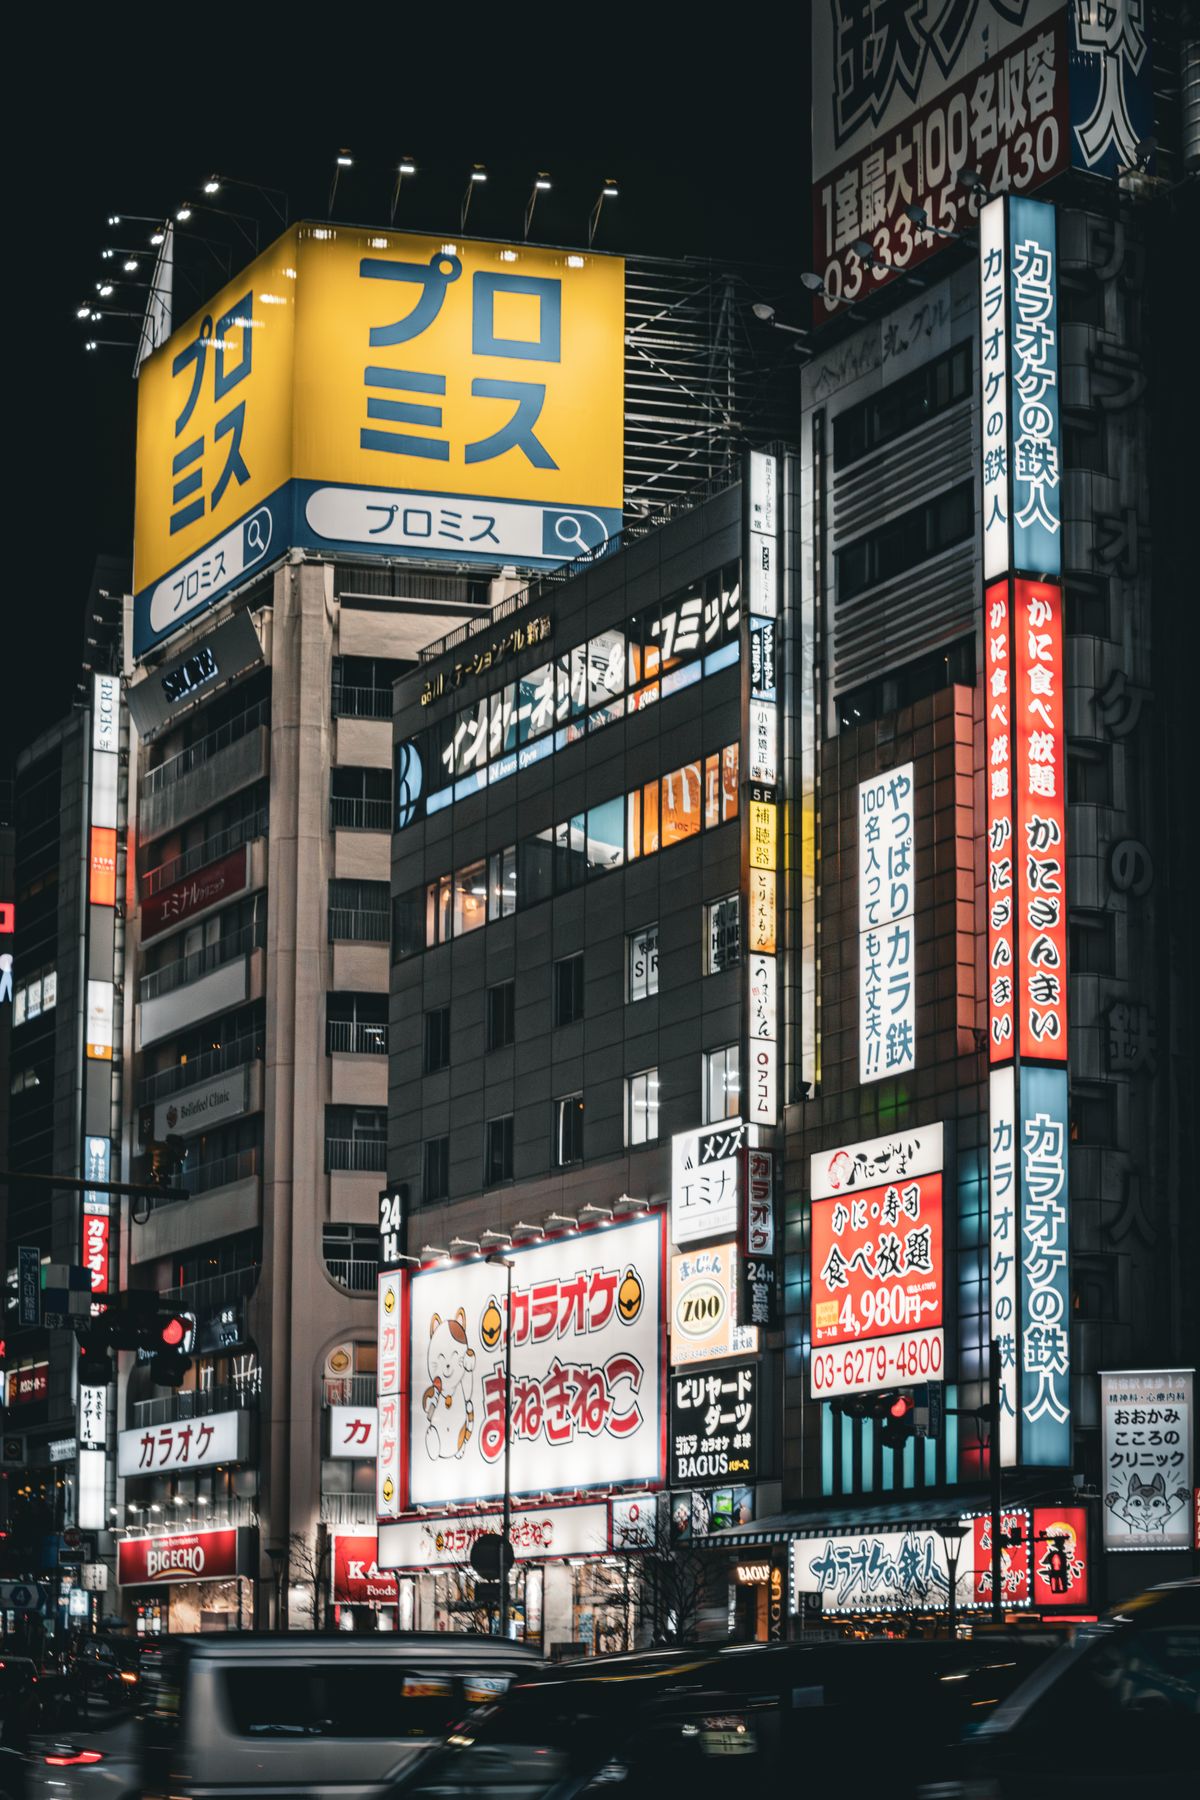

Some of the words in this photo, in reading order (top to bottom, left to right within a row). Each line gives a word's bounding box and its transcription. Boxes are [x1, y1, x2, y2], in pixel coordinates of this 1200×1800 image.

[822, 29, 1056, 258] 1室最大100名収容
[359, 252, 562, 363] プロ
[173, 290, 253, 438] プロ
[984, 247, 1007, 533] カラオケの鉄人
[1012, 239, 1061, 534] カラオケの鉄人
[359, 365, 561, 471] ミス
[169, 400, 251, 536] ミス
[366, 504, 501, 544] プロミス
[173, 551, 227, 613] プロミス
[100, 678, 112, 734] SECRE
[989, 600, 1011, 800] かに食べ放題
[1027, 597, 1057, 797] かに食べ放題
[753, 789, 772, 801] 5F
[755, 806, 770, 865] 補聴器
[757, 875, 768, 945] とりえもん
[861, 785, 886, 1075] 100名入っても大丈夫!!
[886, 774, 913, 1069] やっぱりカラ鉄
[989, 817, 1011, 1045] かにざんまい
[1024, 814, 1061, 1043] かにざんまい
[757, 1070, 769, 1112] アコム
[702, 1126, 745, 1163] メンズ
[847, 1139, 921, 1186] かにざんまい
[379, 1194, 401, 1235] 24
[679, 1170, 738, 1208] エミナ
[751, 1155, 770, 1252] カラオケ
[833, 1184, 920, 1235] かに・寿司
[86, 1217, 105, 1288] カラオケ
[383, 1233, 398, 1262] H
[821, 1226, 932, 1291] 食べ放題
[1022, 1113, 1070, 1425] カラオケの鉄人
[502, 1271, 618, 1346] カラオケ
[683, 1295, 720, 1323] ZOO
[677, 1370, 752, 1408] ビリヤード
[813, 1336, 942, 1391] 03-6279-4800
[84, 1390, 93, 1439] ルノアール
[383, 1327, 396, 1465] カラオケ
[481, 1356, 642, 1461] まねきねこ
[704, 1402, 753, 1436] ダーツ
[1114, 1408, 1181, 1425] おおかみ
[139, 1422, 215, 1468] カラオケ
[675, 1441, 698, 1456] ゴルフ
[678, 1452, 729, 1478] BAGUS
[700, 1435, 730, 1453] カラオケ
[1109, 1450, 1185, 1468] クリニック
[1115, 1430, 1180, 1446] こころの
[147, 1550, 170, 1577] BIG
[170, 1546, 205, 1573] ECHO
[809, 1531, 949, 1606] カラオケの鉄人
[366, 1584, 397, 1597] Foods
[852, 1592, 899, 1605] KARAOKE
